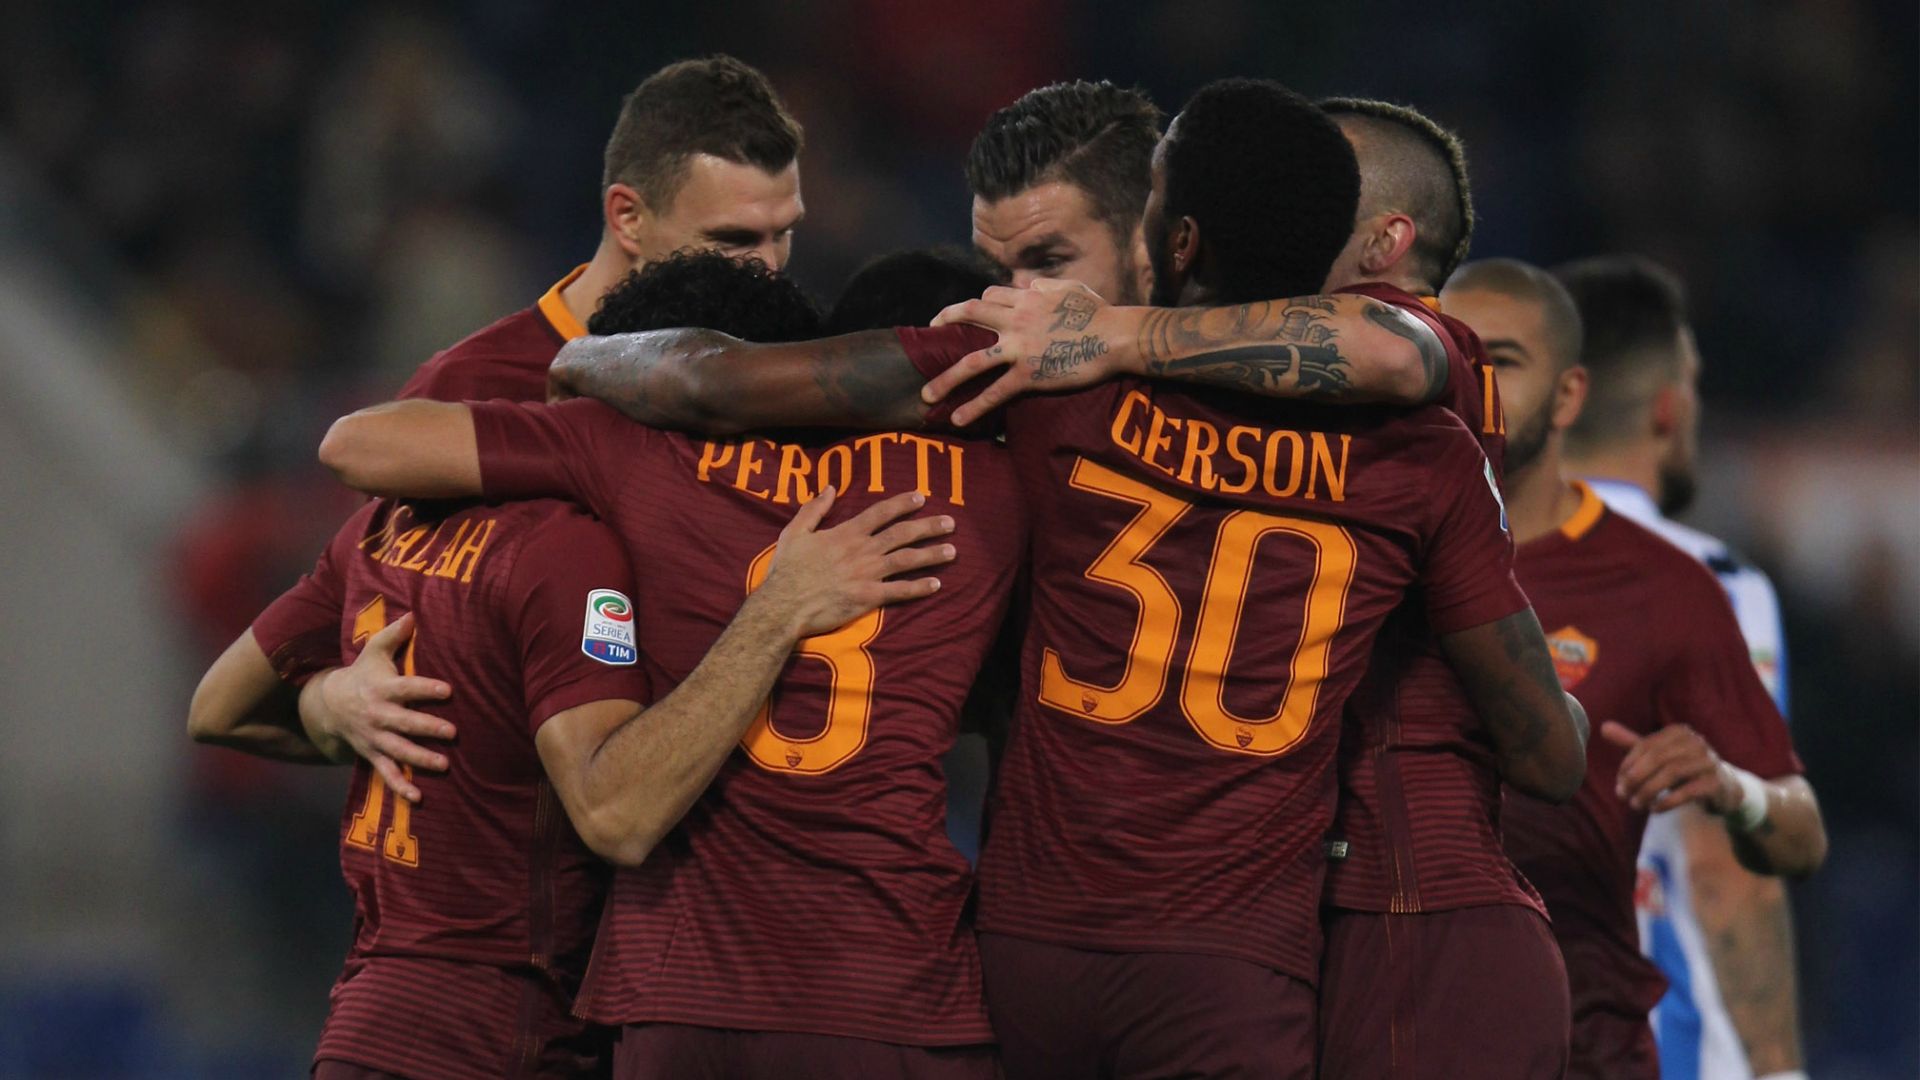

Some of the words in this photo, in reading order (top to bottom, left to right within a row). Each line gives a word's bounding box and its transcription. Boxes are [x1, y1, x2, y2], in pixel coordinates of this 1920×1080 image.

[697, 432, 965, 506] PEROTTI
[1111, 389, 1352, 502] GERSON
[593, 623, 622, 639] SERIE
[623, 631, 633, 643] A
[1038, 455, 1358, 756] 30
[608, 644, 630, 659] TIM
